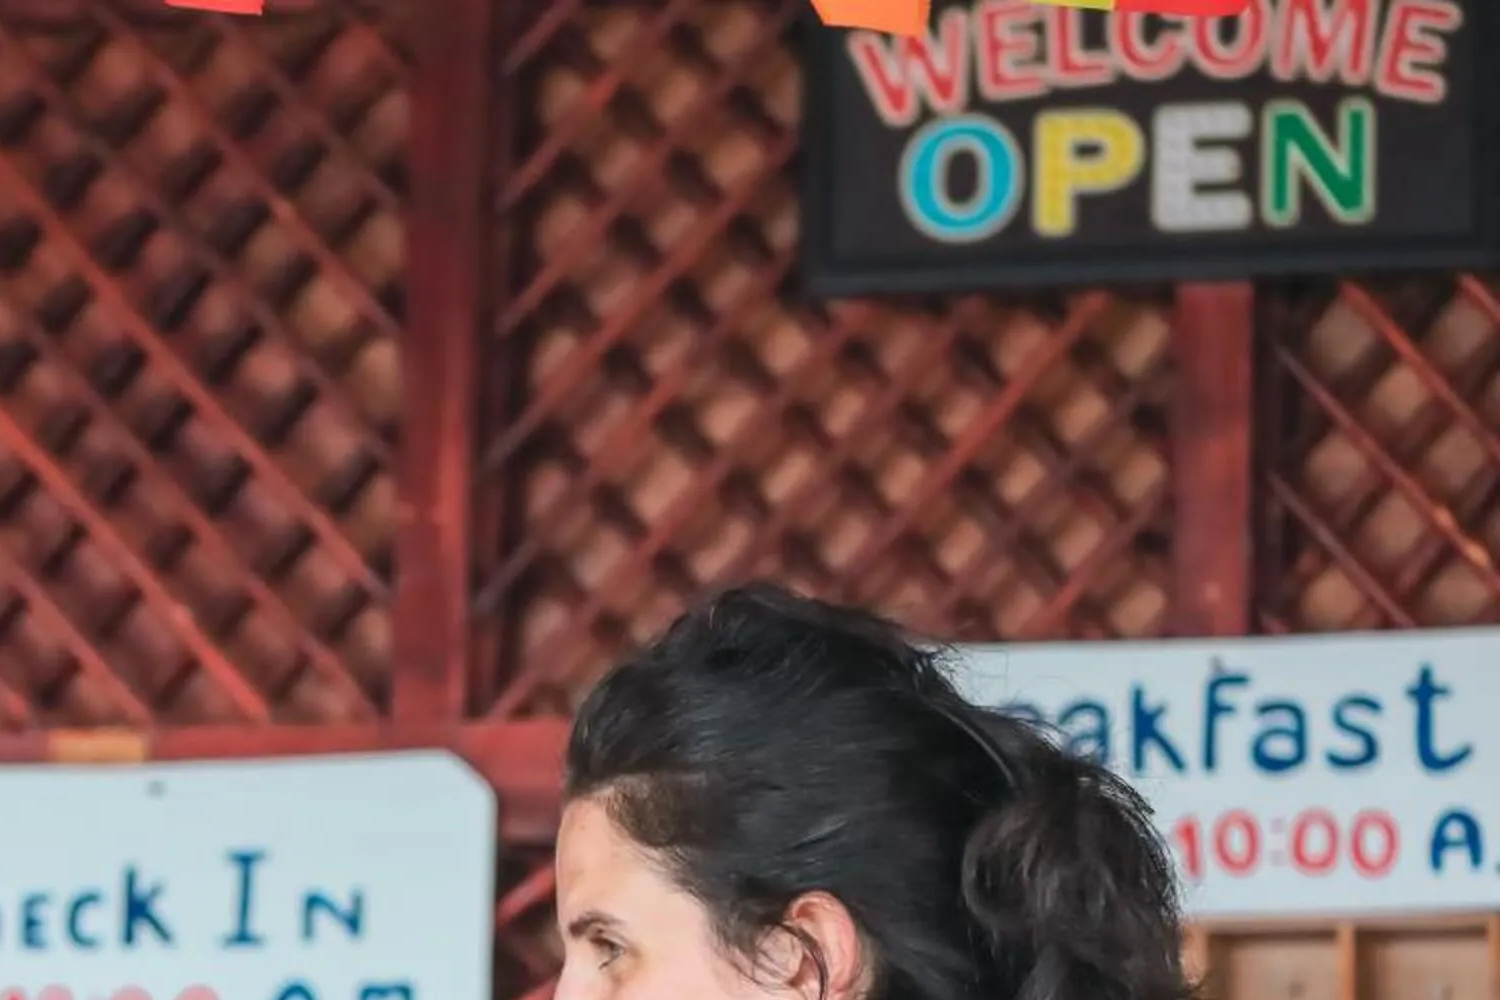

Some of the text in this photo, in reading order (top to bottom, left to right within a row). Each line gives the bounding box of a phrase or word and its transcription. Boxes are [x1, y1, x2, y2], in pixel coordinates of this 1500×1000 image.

[847, 0, 1462, 126] WELCOME
[898, 99, 1374, 243] OPEN
[1003, 664, 1474, 773] akfast
